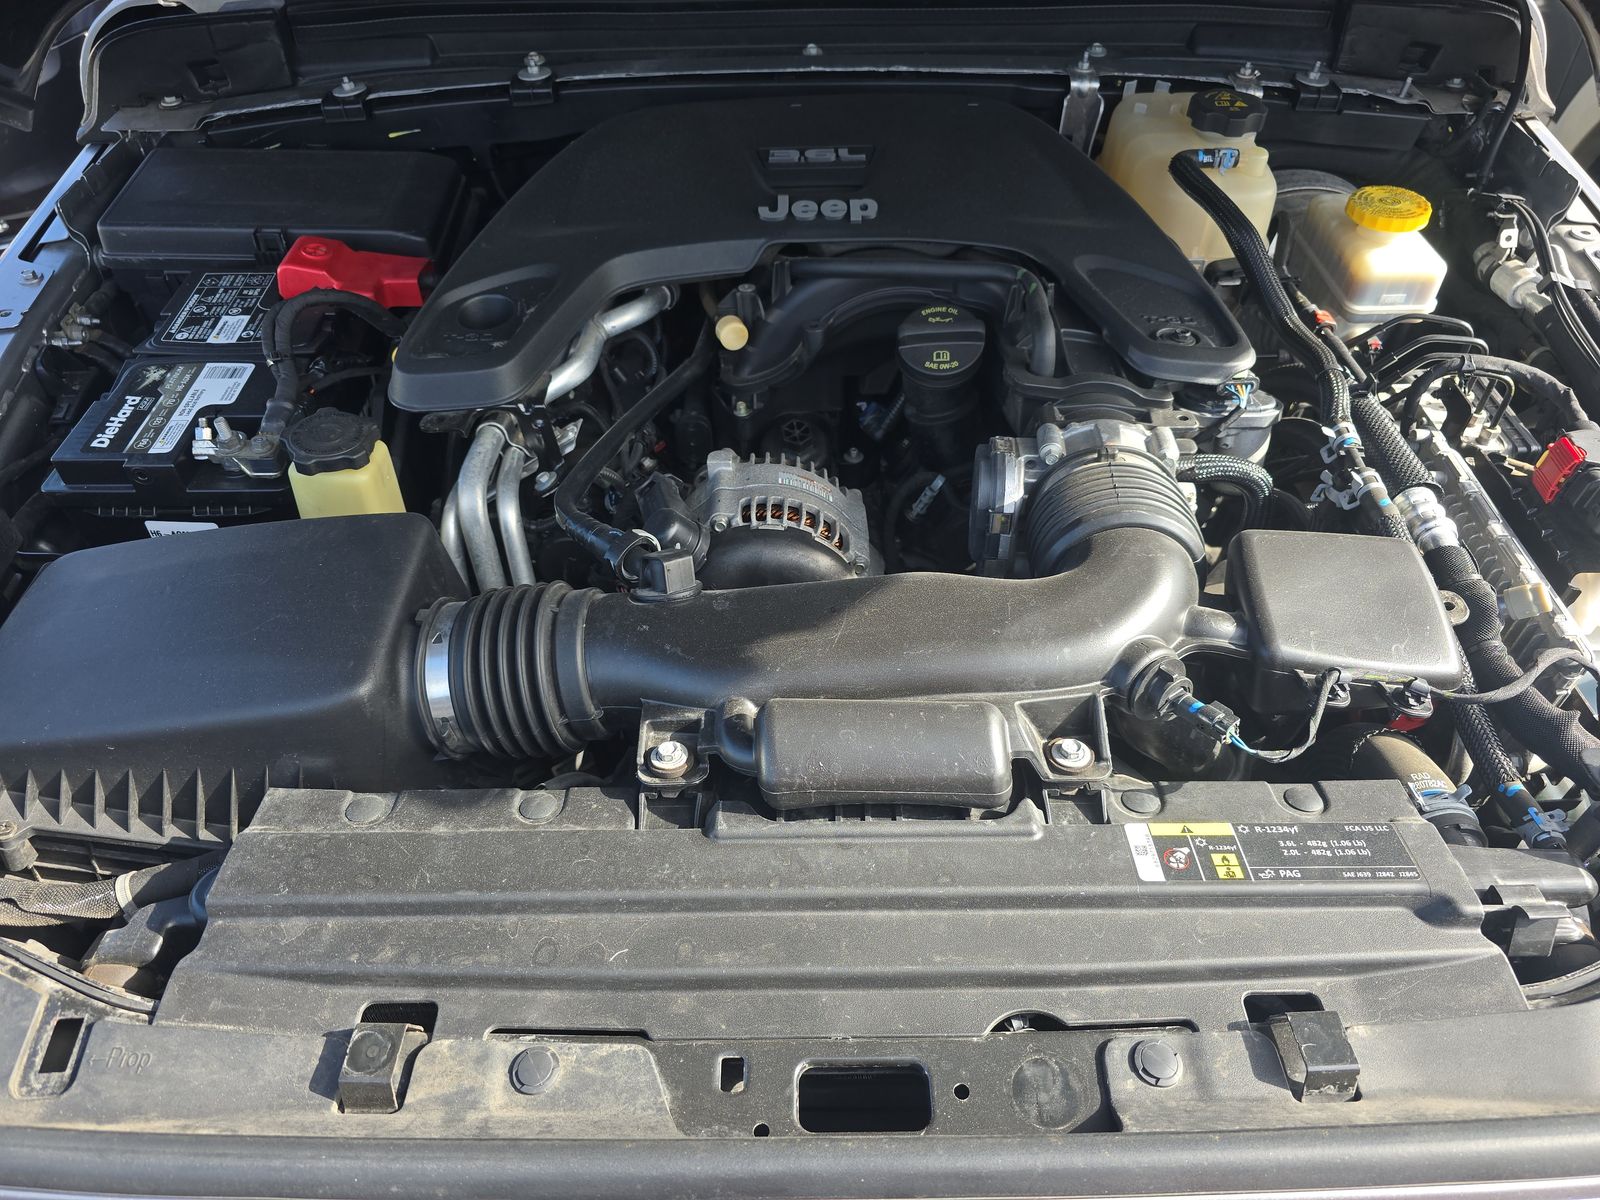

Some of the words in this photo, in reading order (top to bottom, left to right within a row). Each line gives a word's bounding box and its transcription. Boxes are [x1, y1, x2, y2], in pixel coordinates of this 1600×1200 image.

[757, 194, 879, 224] Jeep
[921, 306, 947, 316] ENGINE
[947, 307, 960, 316] OIL
[924, 361, 938, 370] SAE
[939, 360, 960, 370] 0W-20
[90, 396, 141, 448] DieHard
[1410, 772, 1431, 781] RAD
[1254, 825, 1298, 834] R-1234yf
[1306, 840, 1328, 848] 482g
[1330, 839, 1352, 847] (1.06
[1311, 849, 1333, 857] 482g
[1334, 848, 1356, 857] (1.06
[1278, 868, 1301, 878] PAG
[106, 1045, 153, 1074] Prop
